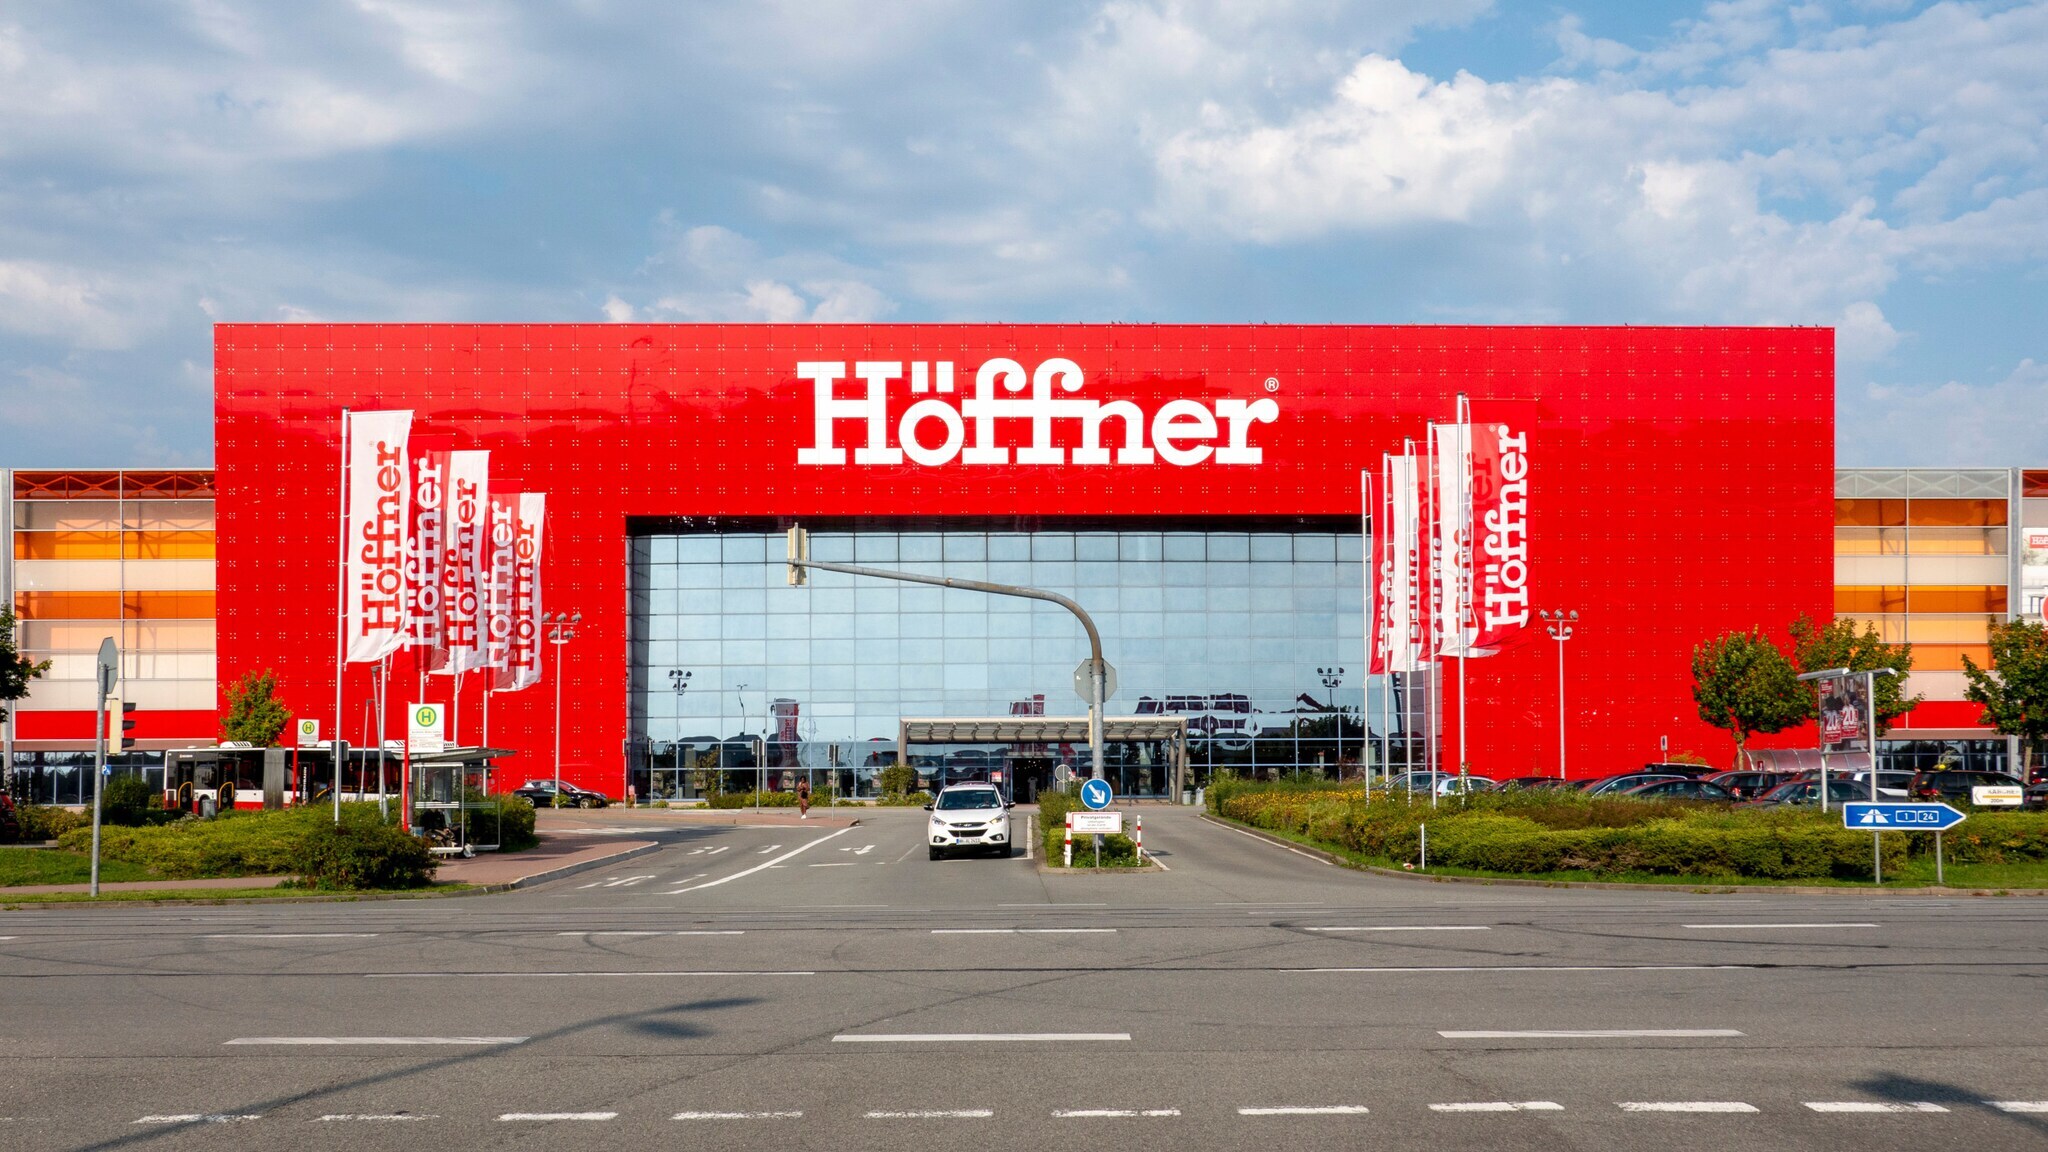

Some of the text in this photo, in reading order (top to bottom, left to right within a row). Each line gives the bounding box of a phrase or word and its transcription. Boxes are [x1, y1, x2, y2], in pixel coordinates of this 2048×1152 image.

[797, 357, 1279, 466] Höffner
[361, 440, 402, 637] Höffner
[403, 457, 442, 652] Höffner
[443, 477, 478, 651] Höffner
[1484, 425, 1528, 632] Höffner
[1922, 812, 1934, 820] 24
